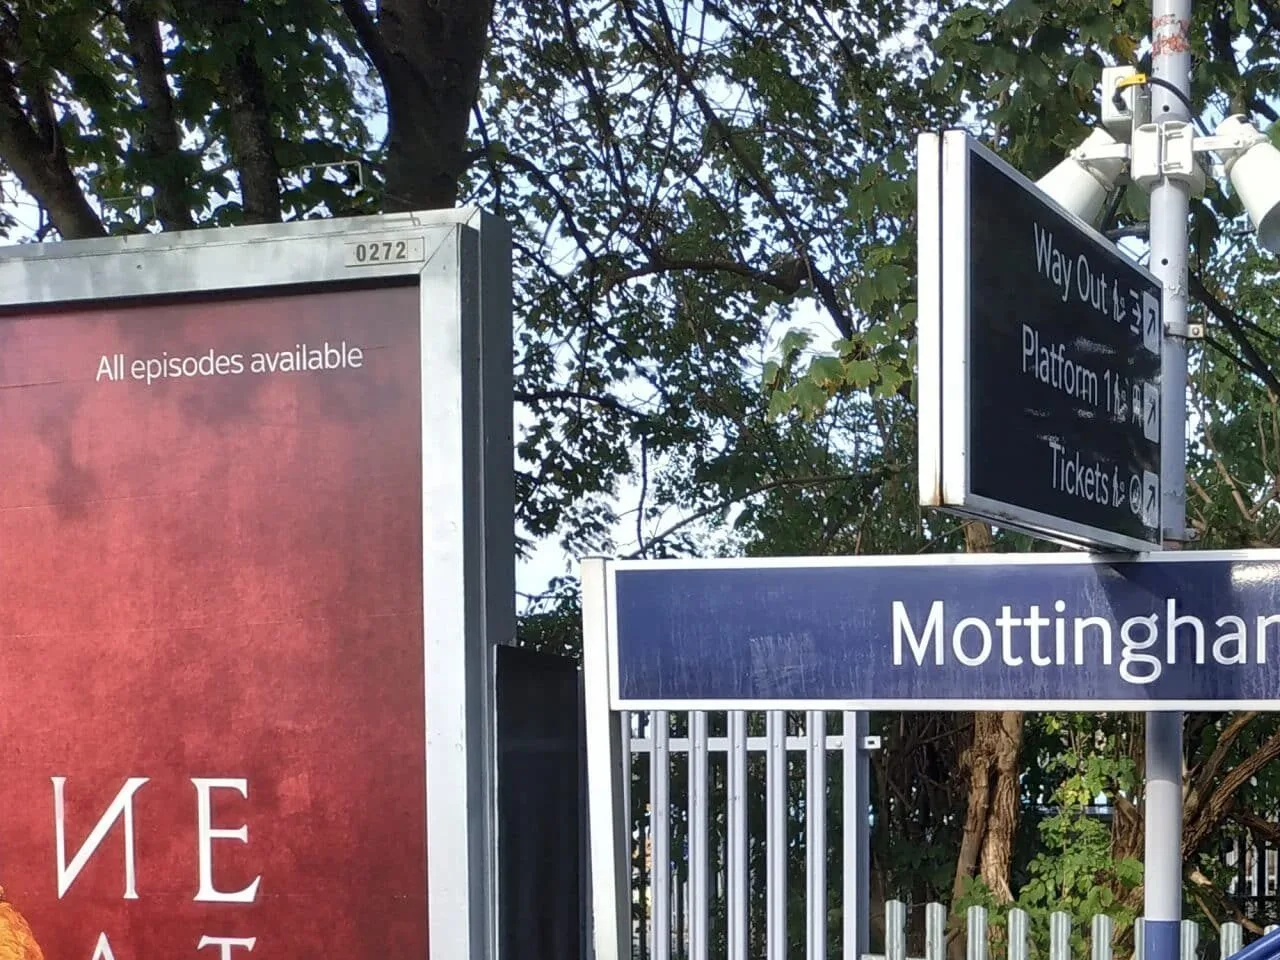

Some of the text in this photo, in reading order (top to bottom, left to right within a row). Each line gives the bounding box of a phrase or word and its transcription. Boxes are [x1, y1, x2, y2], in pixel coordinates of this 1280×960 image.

[355, 240, 408, 264] 0272
[1034, 222, 1107, 316] Way Out
[96, 341, 363, 385] All episodes available
[1022, 323, 1111, 412] Platform 1
[1049, 441, 1109, 506] Tickets
